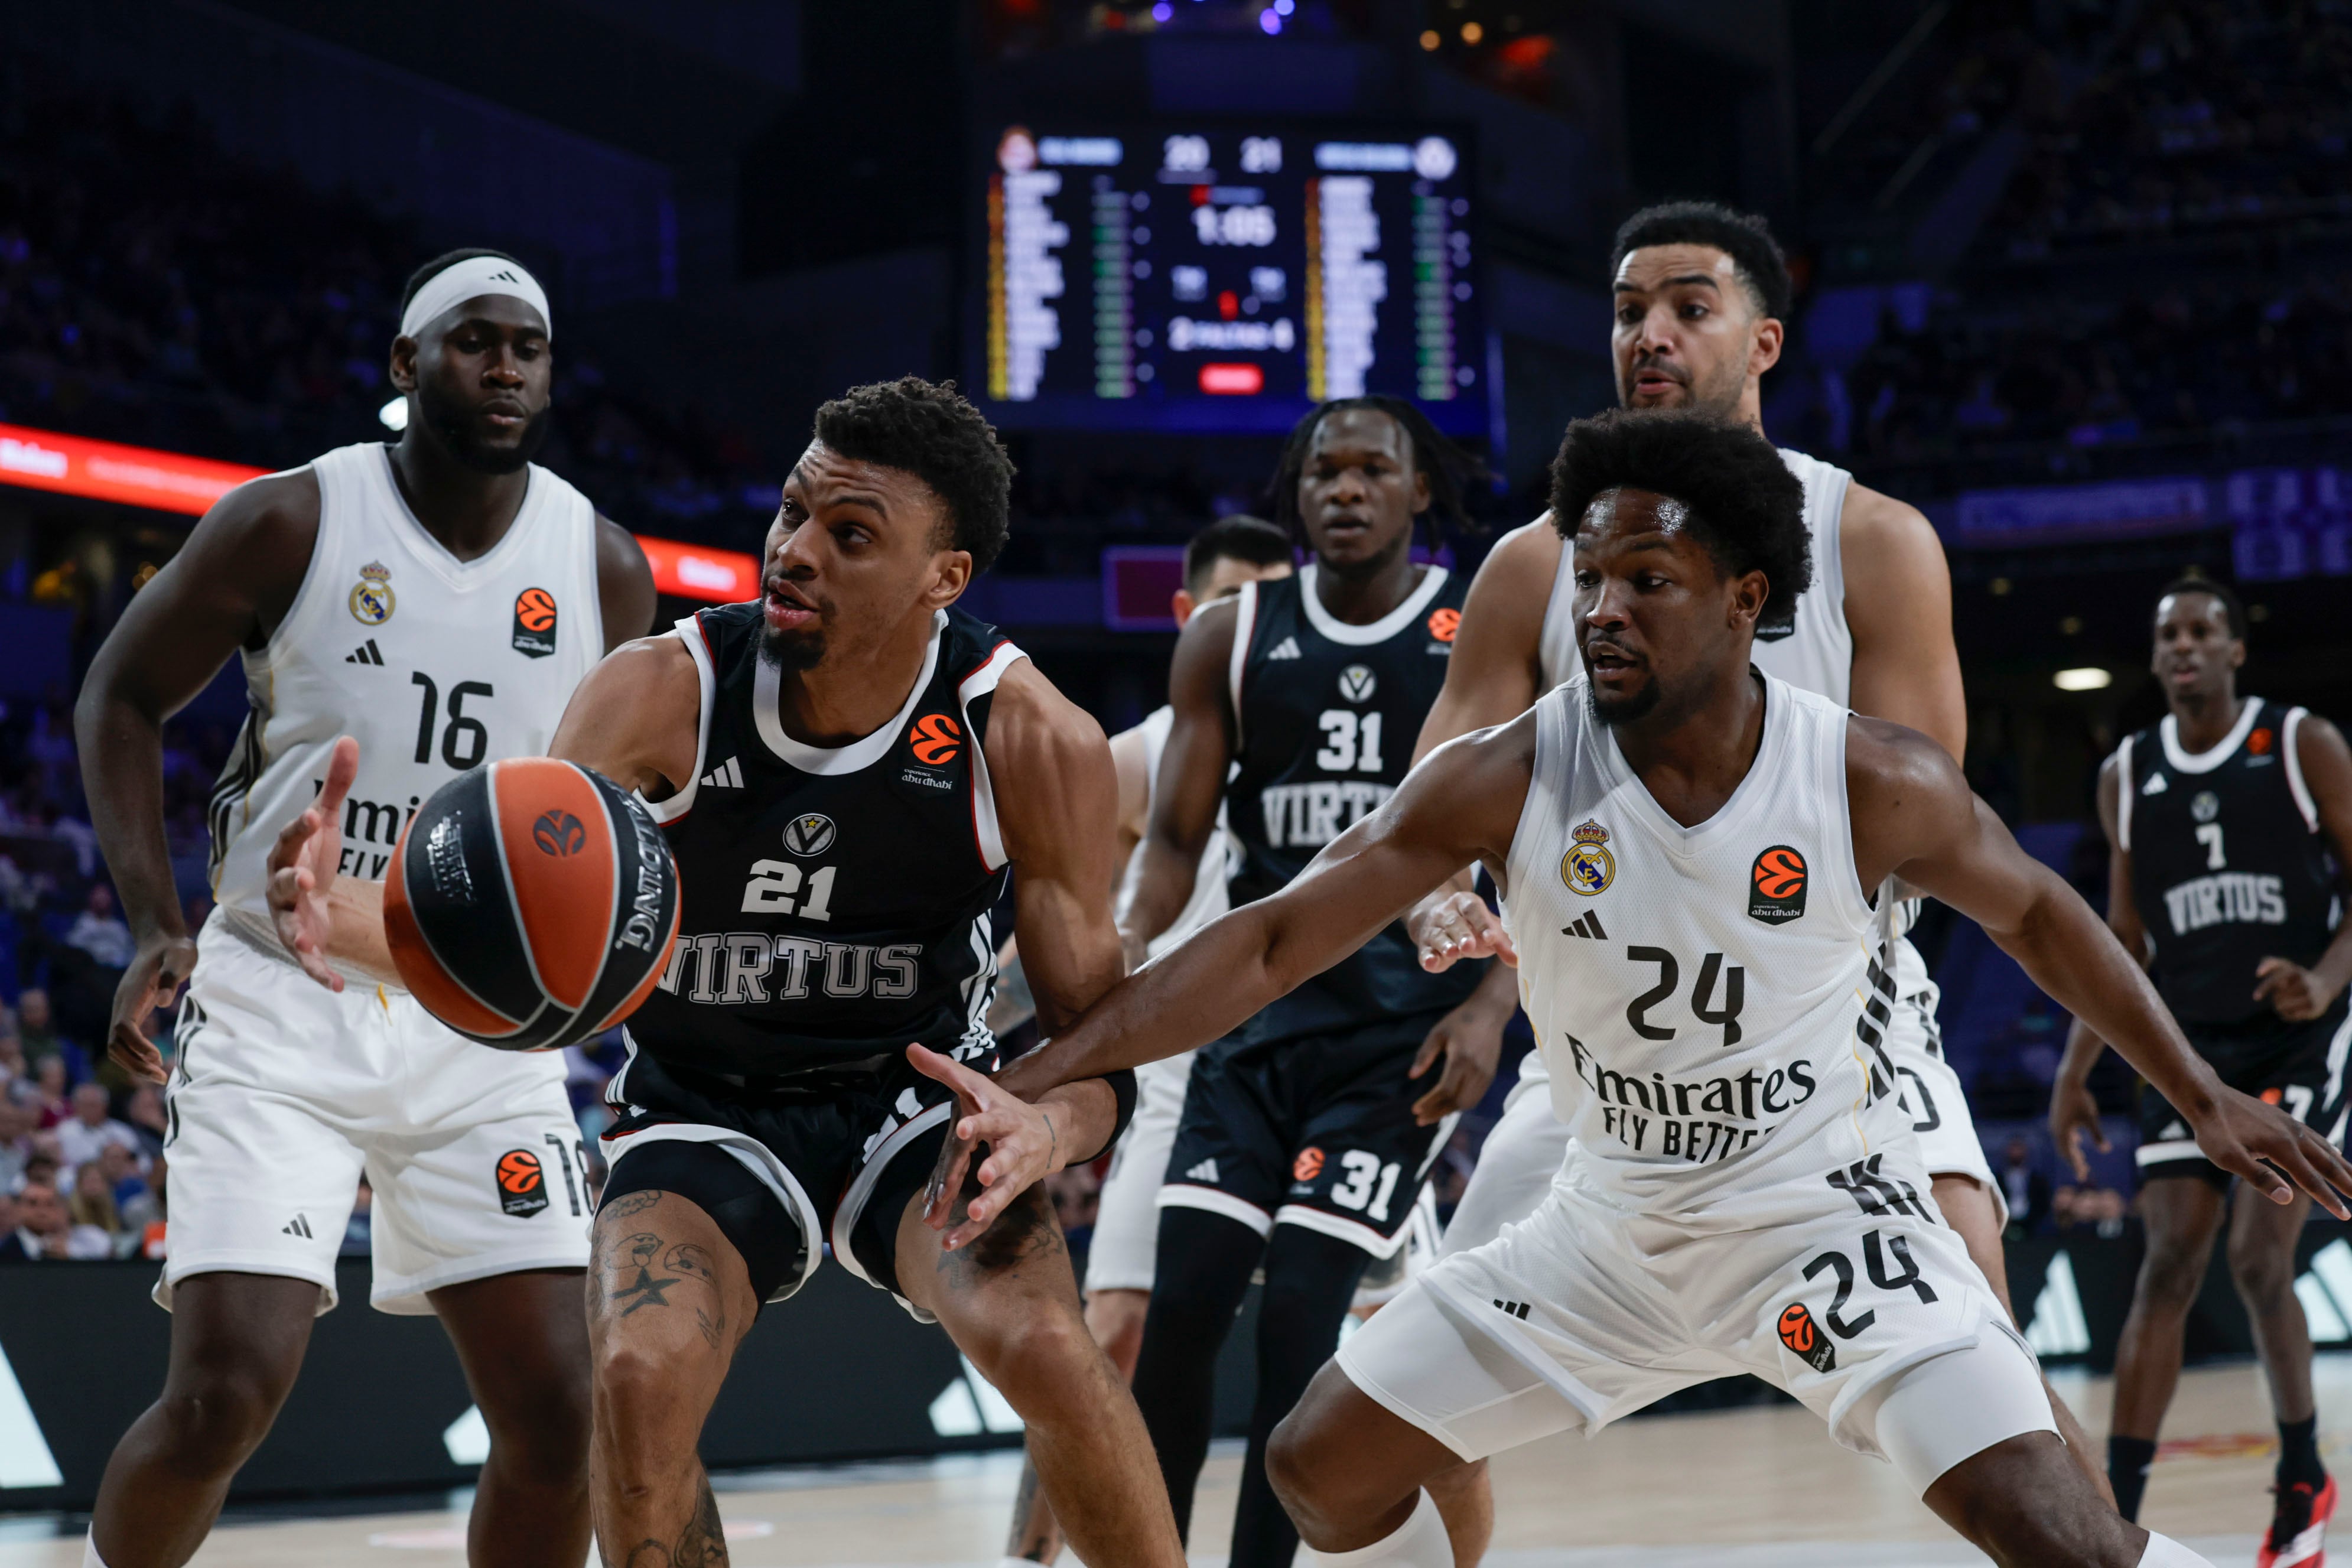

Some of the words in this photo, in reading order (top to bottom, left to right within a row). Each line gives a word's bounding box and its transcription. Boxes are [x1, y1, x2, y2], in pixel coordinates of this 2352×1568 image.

[412, 671, 493, 770] 16
[1317, 710, 1382, 772] 31
[901, 774, 922, 784] abu
[922, 778, 953, 789] dhabi
[2196, 824, 2227, 870] 7
[741, 858, 837, 922] 21
[2164, 871, 2286, 935] VIRTUS
[655, 932, 923, 1004] VIRTUS
[1626, 945, 1745, 1046] 24
[1564, 1032, 1816, 1120] Emirates
[2285, 1084, 2314, 1124] 7
[1603, 1107, 1648, 1151] FLY
[1330, 1149, 1401, 1221] 31
[1802, 1229, 1938, 1339] 24
